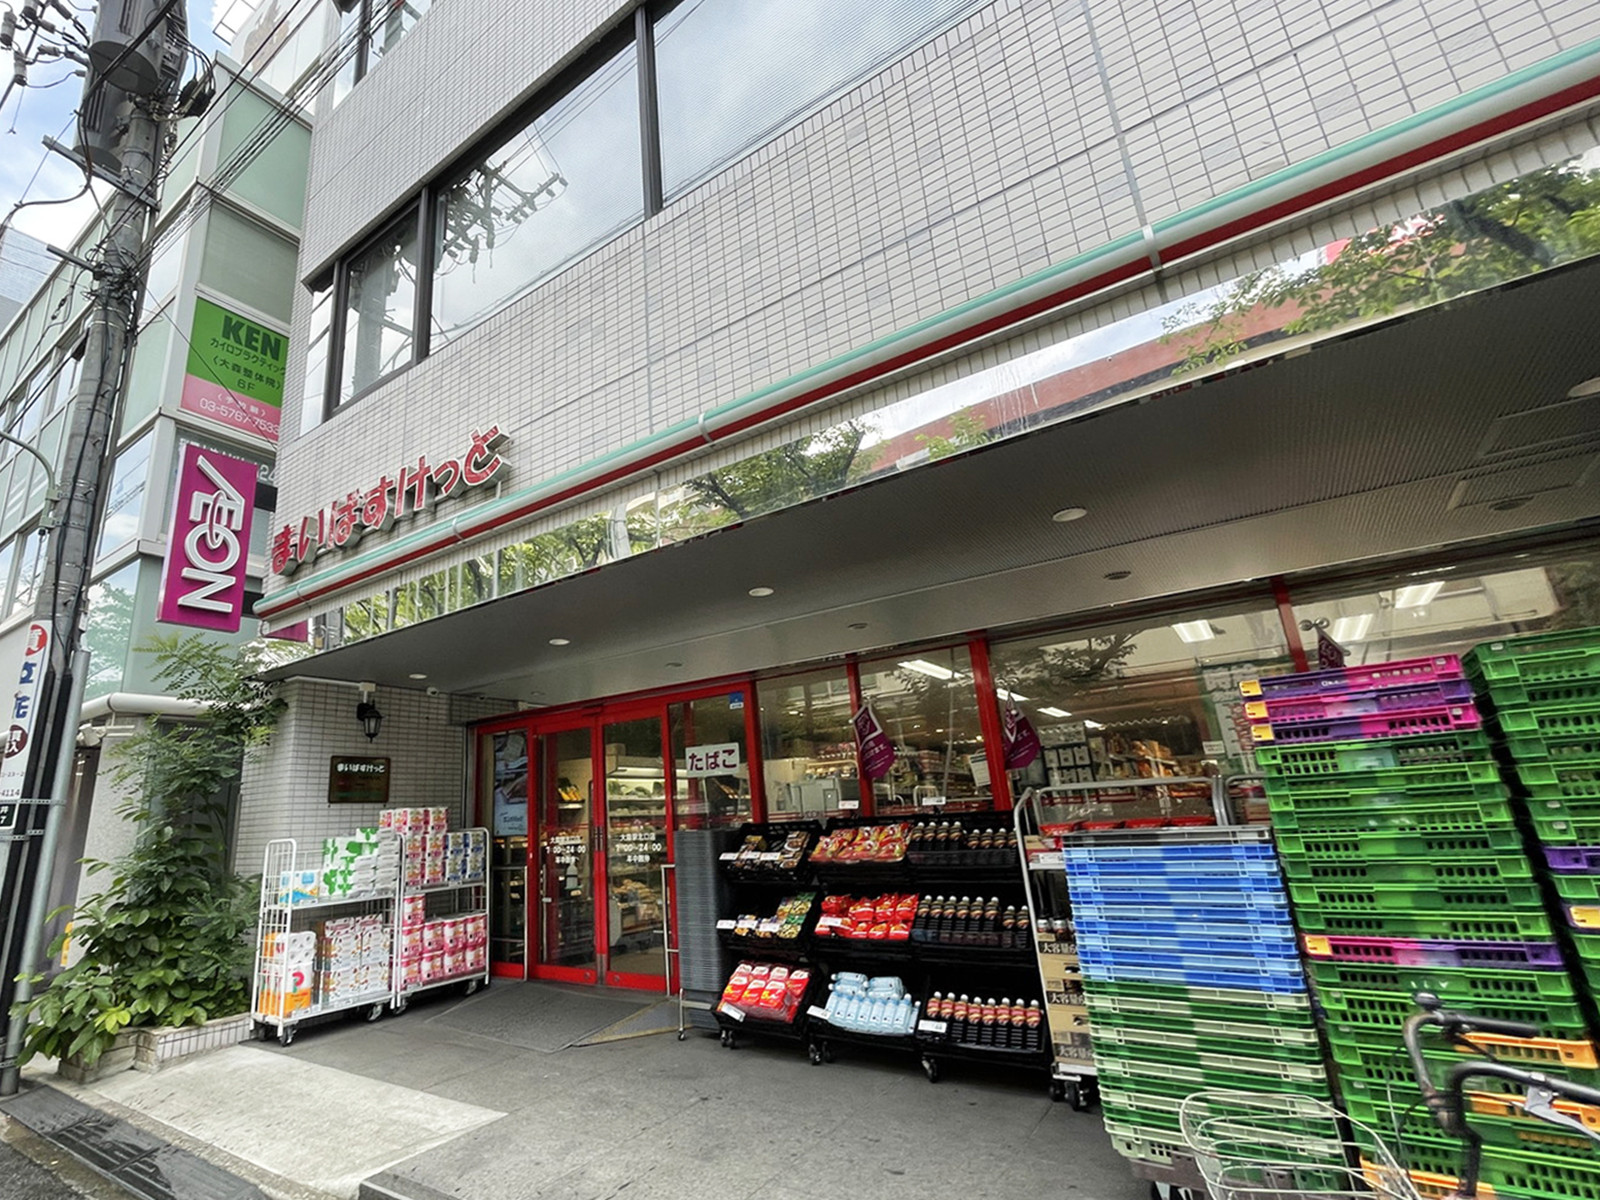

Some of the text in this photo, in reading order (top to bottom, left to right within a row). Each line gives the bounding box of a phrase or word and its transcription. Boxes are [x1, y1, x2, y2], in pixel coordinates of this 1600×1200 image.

[222, 315, 281, 361] KEN
[236, 378, 256, 391] 6F
[271, 424, 510, 576] まいばすけっと
[178, 455, 246, 613] AEON
[688, 748, 737, 771] たばこ
